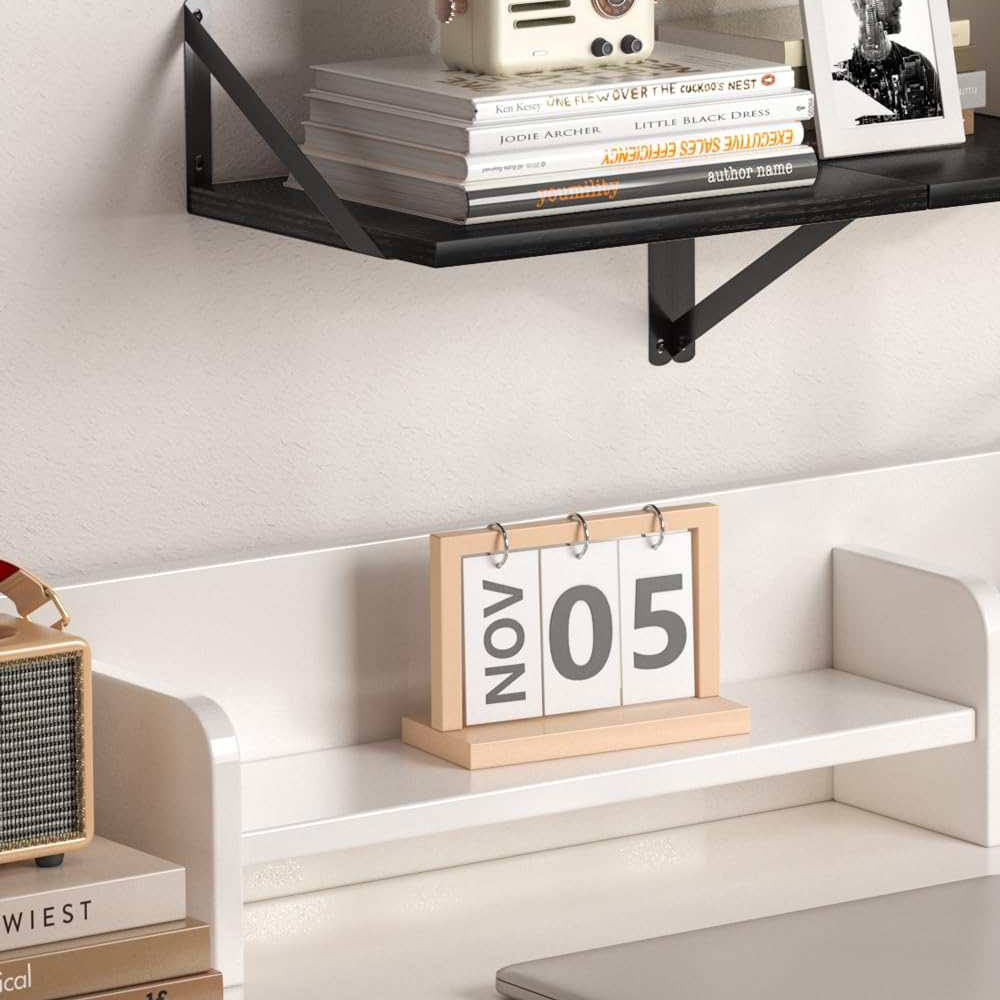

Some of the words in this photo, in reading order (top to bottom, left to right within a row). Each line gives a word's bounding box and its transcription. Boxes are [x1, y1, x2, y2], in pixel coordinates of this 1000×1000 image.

[496, 104, 514, 114] Ken
[516, 101, 542, 112] Kesey
[546, 96, 572, 108] ONE
[612, 87, 648, 101] OVER
[653, 82, 676, 96] THE
[680, 81, 724, 94] CUCKOO'S
[728, 79, 757, 91] NEST
[500, 132, 540, 145] JODIE
[544, 126, 601, 140] ARCHER
[634, 118, 678, 130] LITTLE
[683, 114, 726, 126] BLACK
[731, 108, 771, 120] DRESS
[724, 128, 794, 148] EXECUTIVE
[600, 141, 677, 166] EFFICIENCY
[680, 136, 722, 154] SALES
[707, 165, 753, 184] author
[756, 162, 794, 177] name
[481, 580, 527, 705] NOV
[548, 573, 688, 682] 05
[2, 900, 92, 934] WIEST
[0, 963, 32, 992] ical
